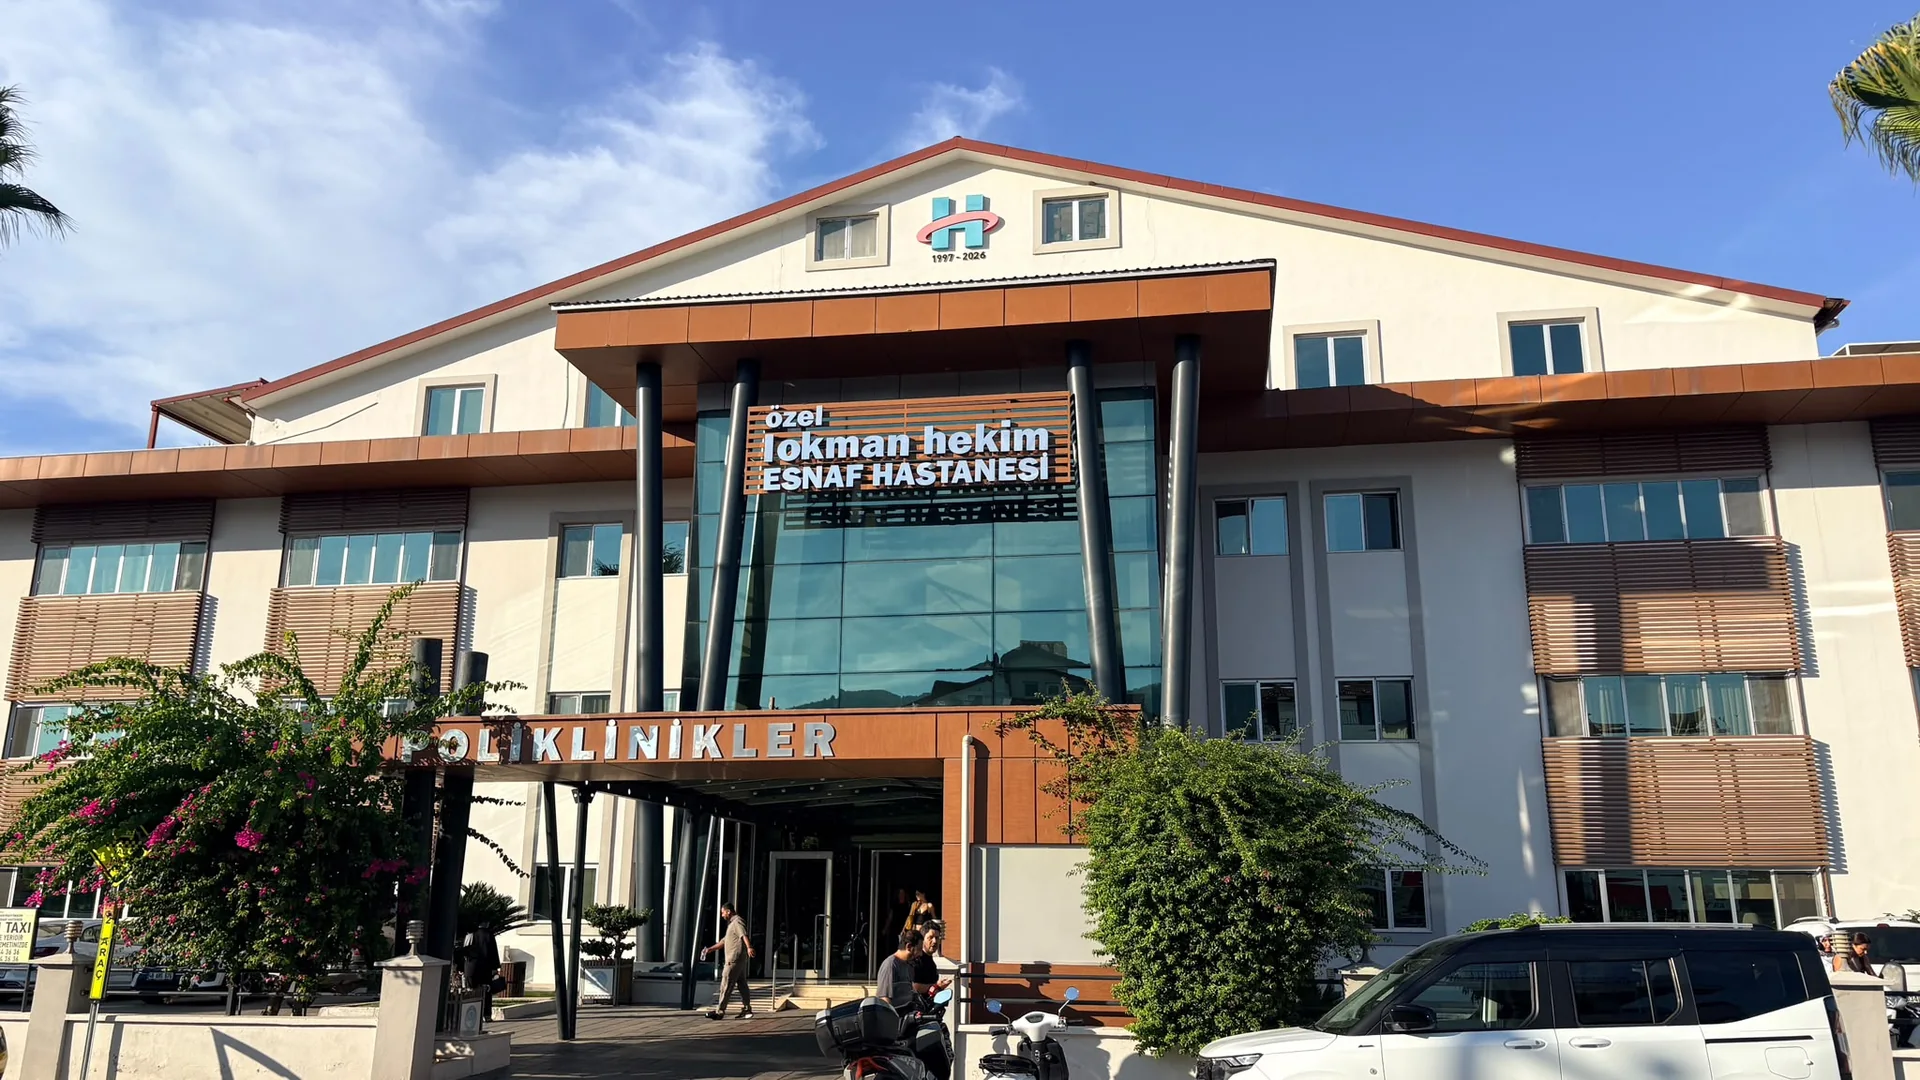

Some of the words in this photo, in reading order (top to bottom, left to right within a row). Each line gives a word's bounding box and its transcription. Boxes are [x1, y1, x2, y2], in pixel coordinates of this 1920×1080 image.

[765, 405, 823, 429] özel
[763, 430, 910, 463] lokman
[923, 419, 1049, 455] hekim
[763, 463, 864, 492] ESNAF
[872, 452, 1049, 488] HASTANESİ
[401, 718, 837, 763] POLİKLİNİKLER
[6, 921, 31, 933] TAXI
